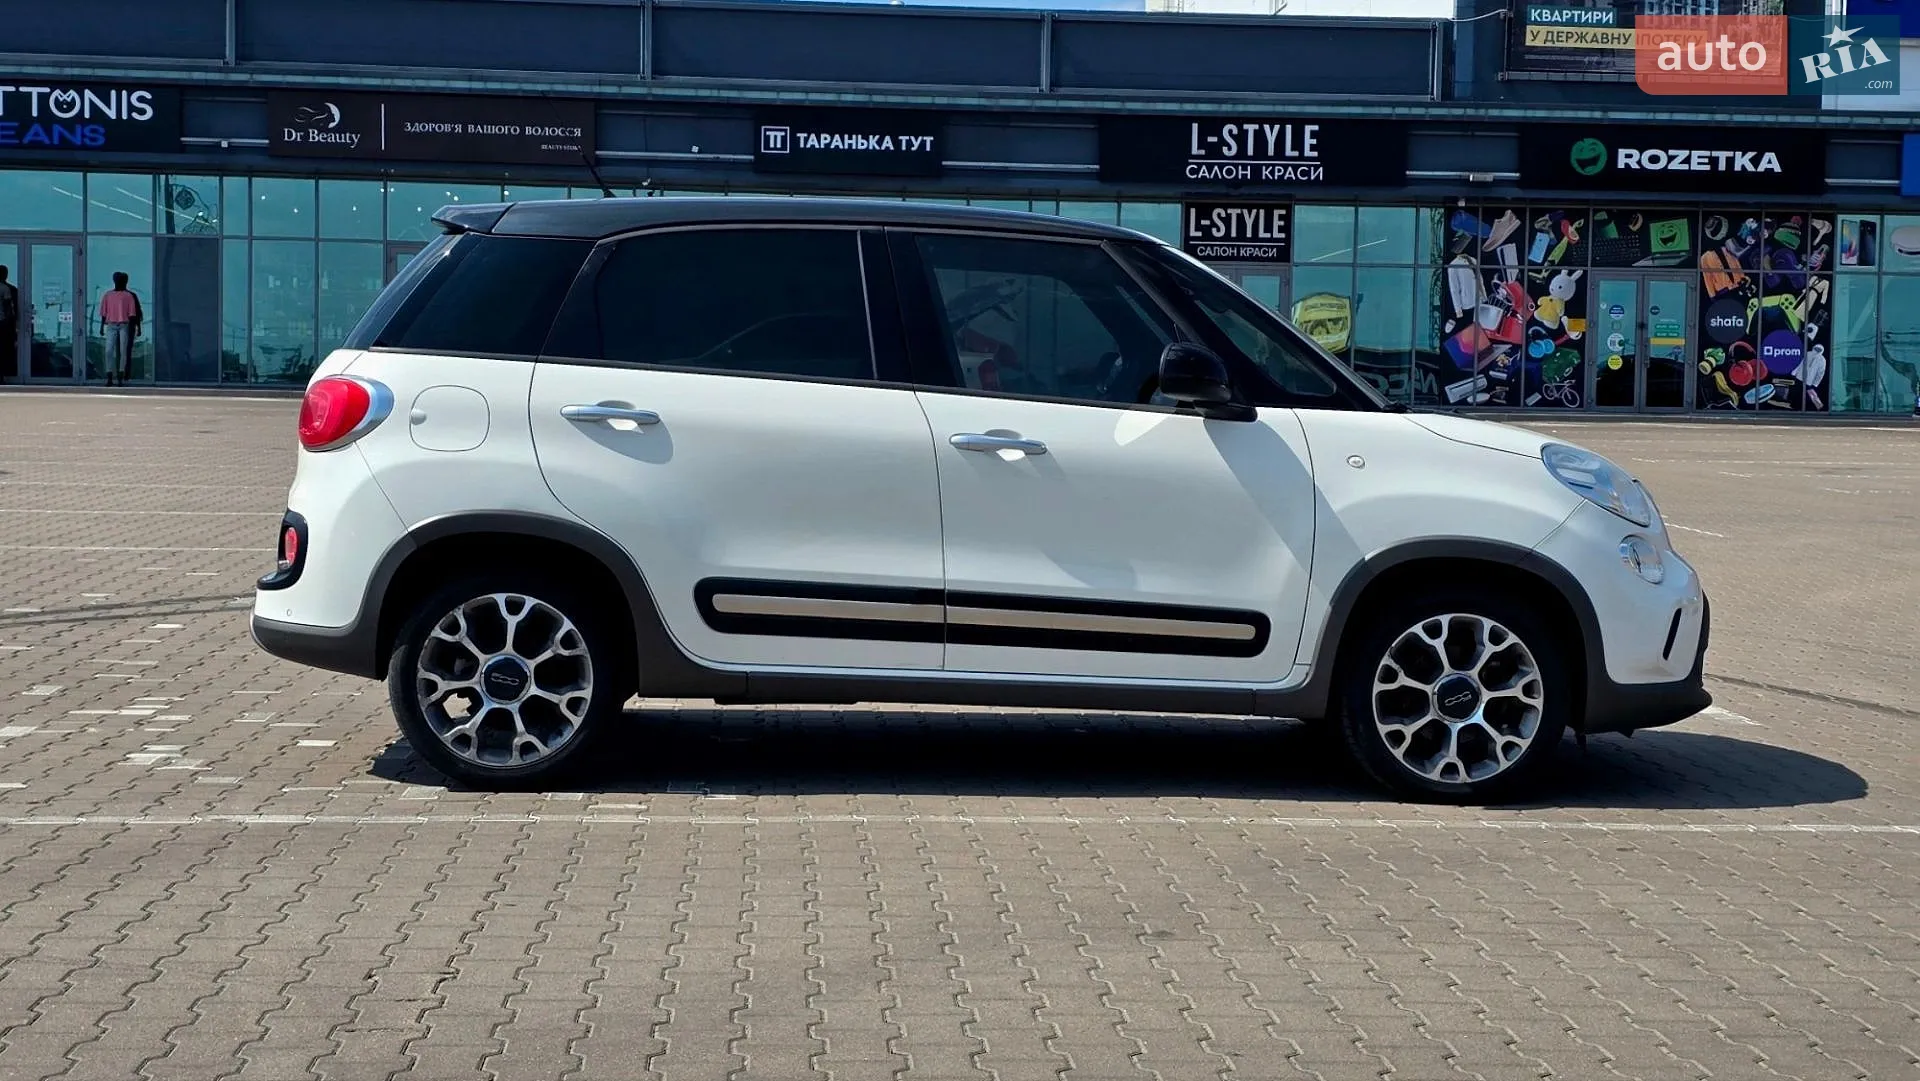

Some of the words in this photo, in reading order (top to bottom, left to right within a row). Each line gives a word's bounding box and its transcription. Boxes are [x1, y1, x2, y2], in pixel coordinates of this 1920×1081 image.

[1530, 8, 1614, 24] КВАРТИРИ
[1530, 30, 1541, 42] У
[1543, 31, 1633, 46] ДЕРЖАВНУ
[283, 128, 304, 142] Dr
[308, 129, 361, 149] Beauty
[468, 124, 520, 136] ВАШОГО
[525, 126, 582, 137] ВОЛОССЯ
[796, 133, 894, 150] ТАРАНЬКА
[898, 135, 934, 151] ТУТ
[1191, 122, 1319, 157] L-STYLE
[1617, 148, 1782, 173] ROZETKA
[1185, 164, 1251, 180] САЛОН
[1262, 165, 1323, 181] КРАСИ
[1189, 207, 1286, 238] L-STYLE
[1197, 246, 1237, 257] САЛОН
[1240, 247, 1277, 258] КРАСИ
[1710, 315, 1744, 328] shafa
[1773, 346, 1801, 358] prom
